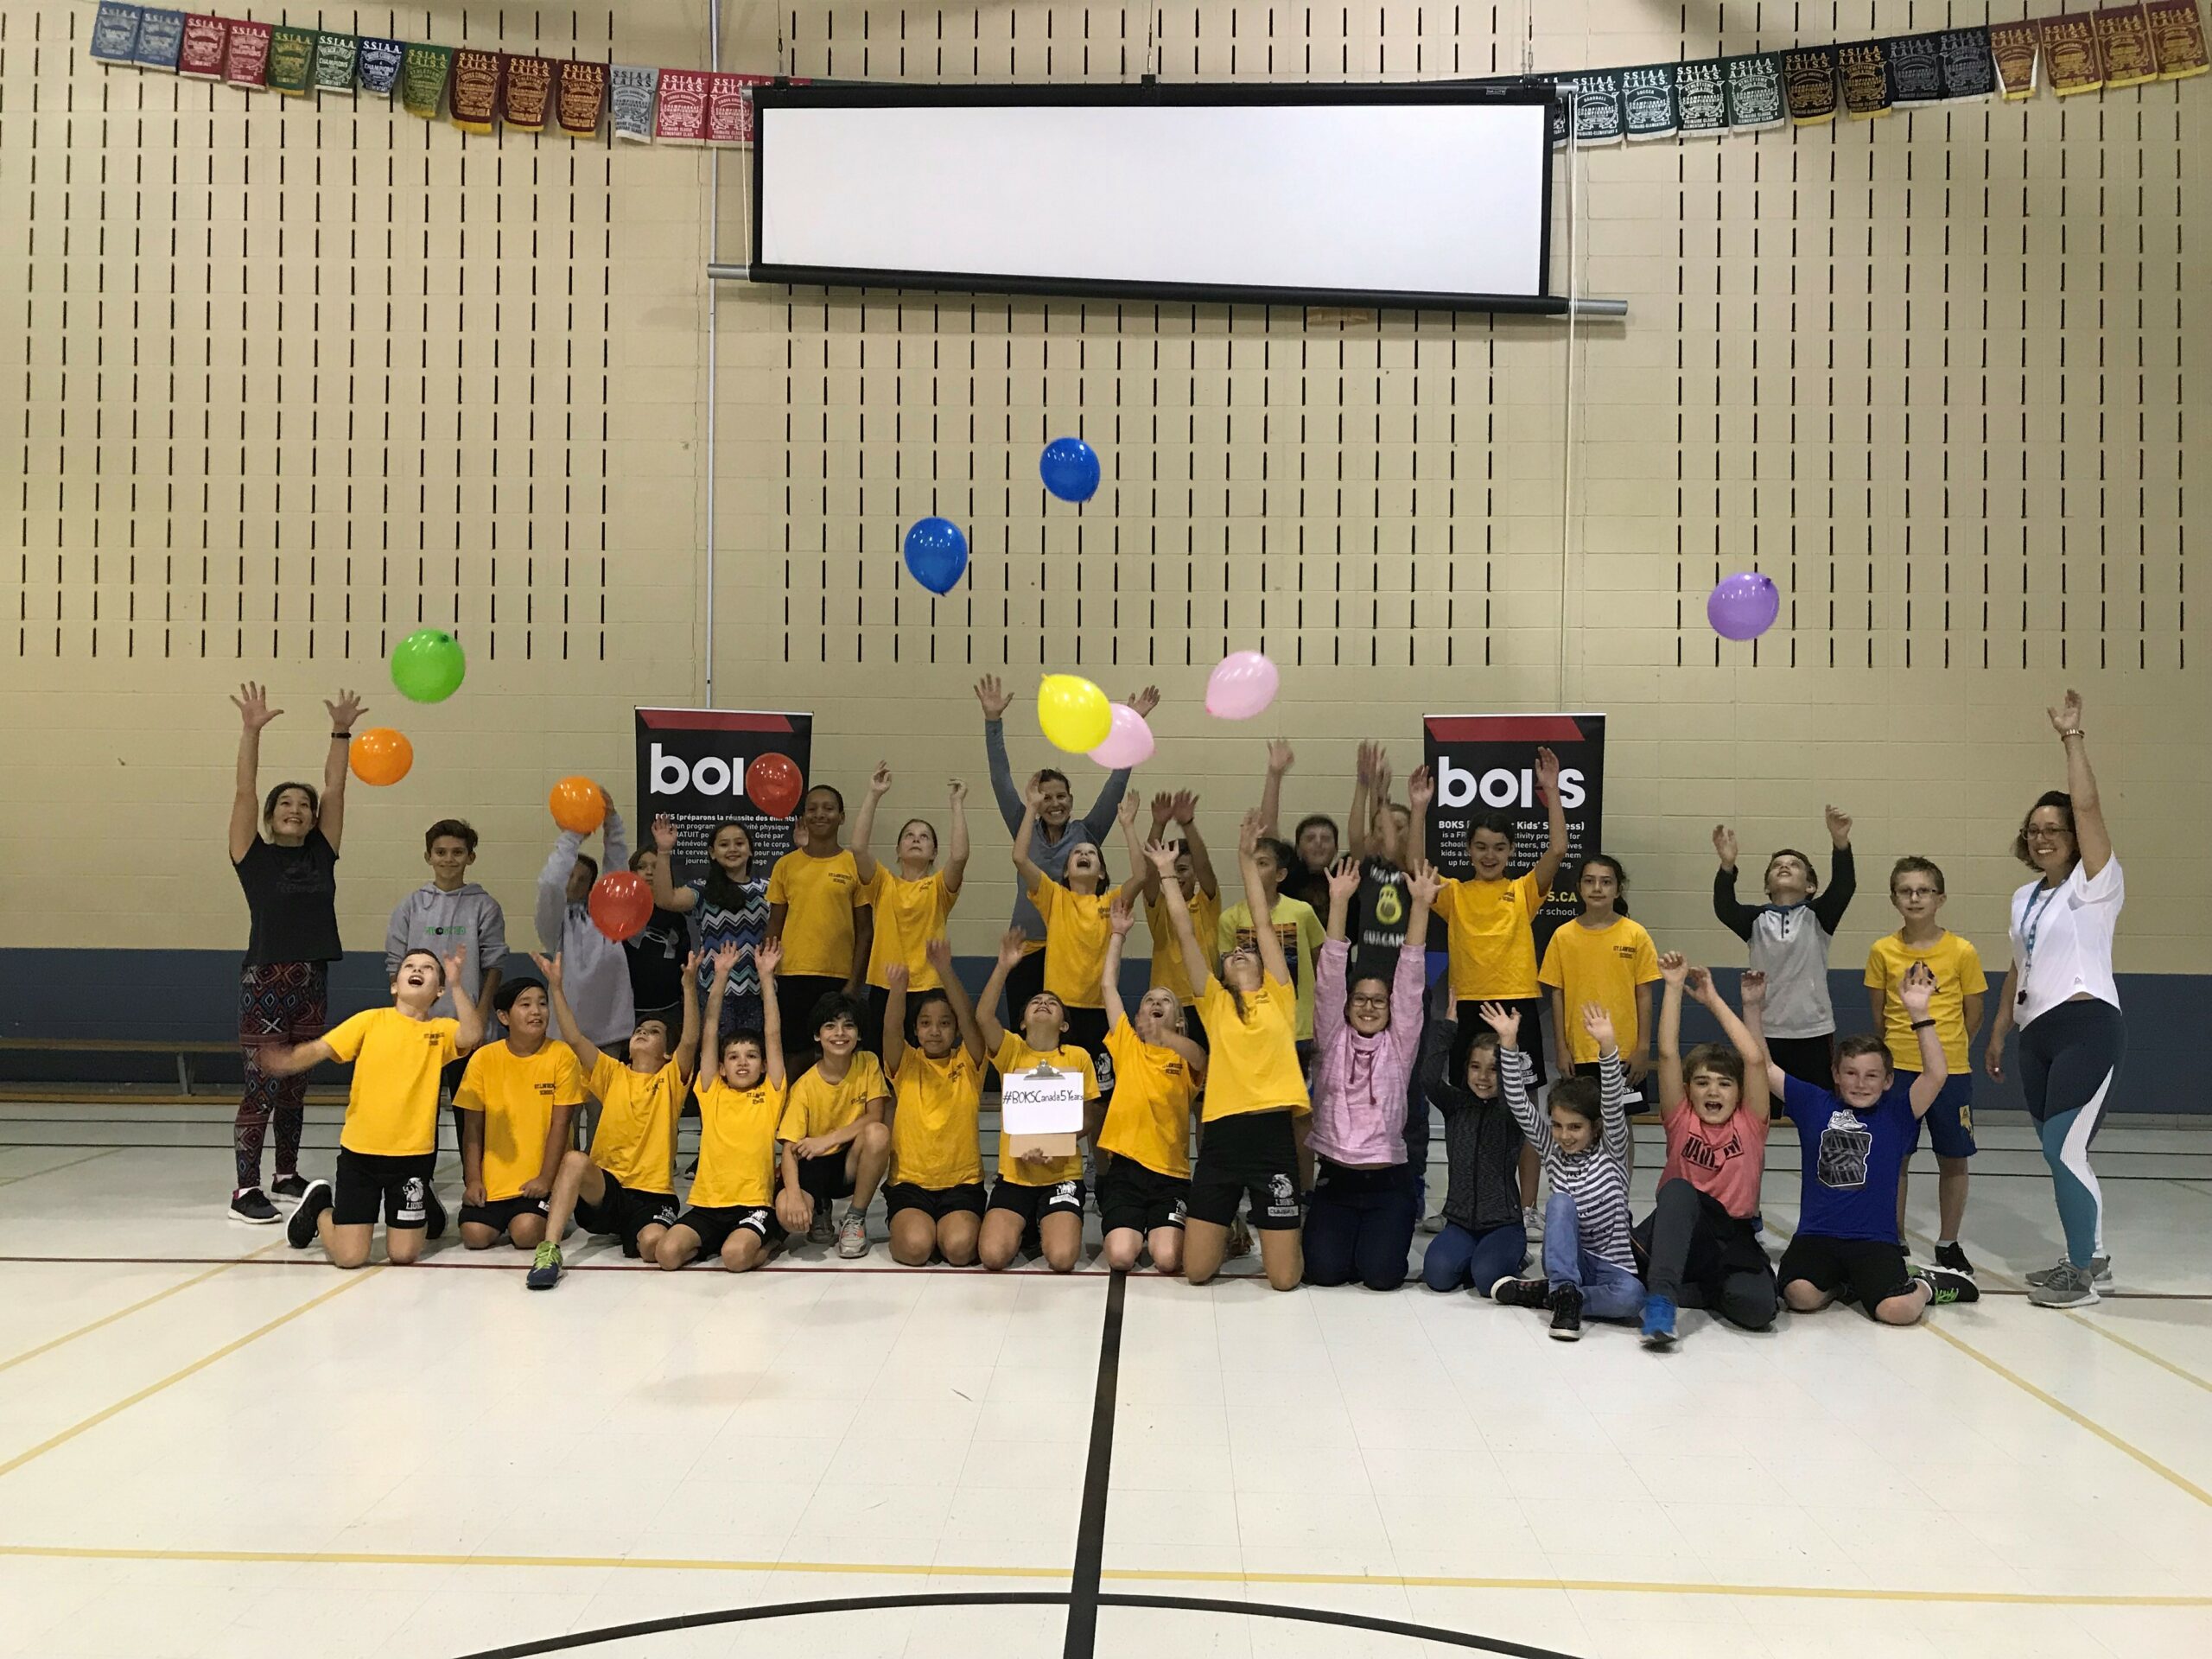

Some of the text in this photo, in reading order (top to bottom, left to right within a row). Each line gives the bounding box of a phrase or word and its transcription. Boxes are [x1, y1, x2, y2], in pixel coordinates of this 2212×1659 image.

[1439, 820, 1465, 829] BOKS
[1516, 821, 1541, 830] Kids'
[685, 857, 710, 866] journé
[1517, 860, 1530, 868] day
[1547, 891, 1578, 903] S.CA
[1546, 907, 1579, 916] school.
[1363, 930, 1406, 948] GUACAM
